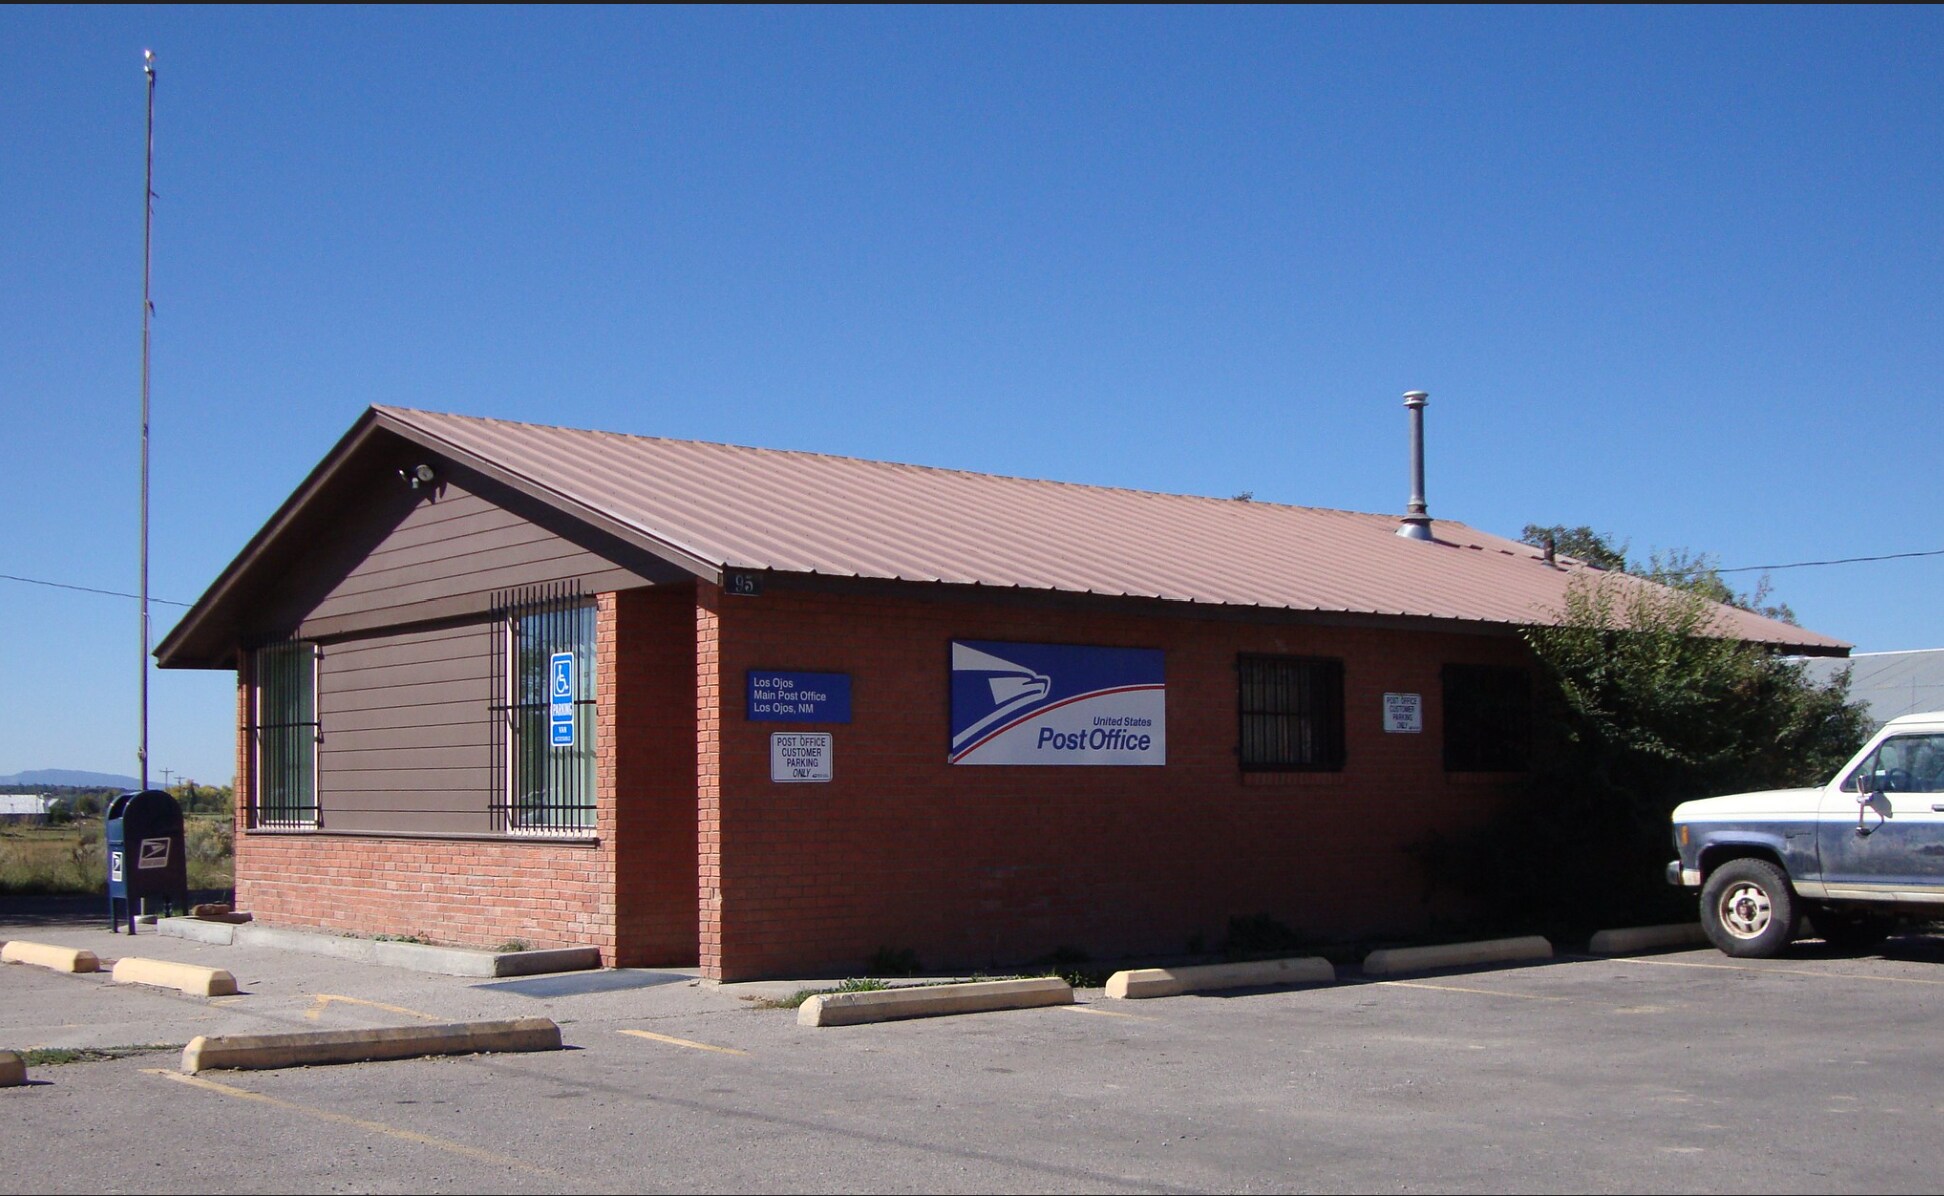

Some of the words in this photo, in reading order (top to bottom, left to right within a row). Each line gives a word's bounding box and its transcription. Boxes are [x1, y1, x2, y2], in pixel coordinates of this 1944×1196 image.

[735, 575, 754, 592] 95
[753, 677, 771, 687] Los
[772, 677, 794, 690] Ojos
[753, 690, 776, 700] Main
[778, 690, 798, 700] Post
[800, 691, 827, 701] Office
[552, 702, 572, 716] PARKING
[753, 702, 771, 712] Los
[772, 702, 796, 715] Ojos,
[798, 703, 814, 713] NM
[1093, 716, 1122, 726] United
[1123, 717, 1152, 727] States
[777, 737, 797, 746] POST
[800, 737, 826, 747] OFFICE
[1037, 727, 1087, 750] Post
[1089, 728, 1151, 751] Office
[781, 747, 821, 757] CUSTOMER
[786, 758, 819, 767] PARKING
[792, 768, 811, 778] ONLY
